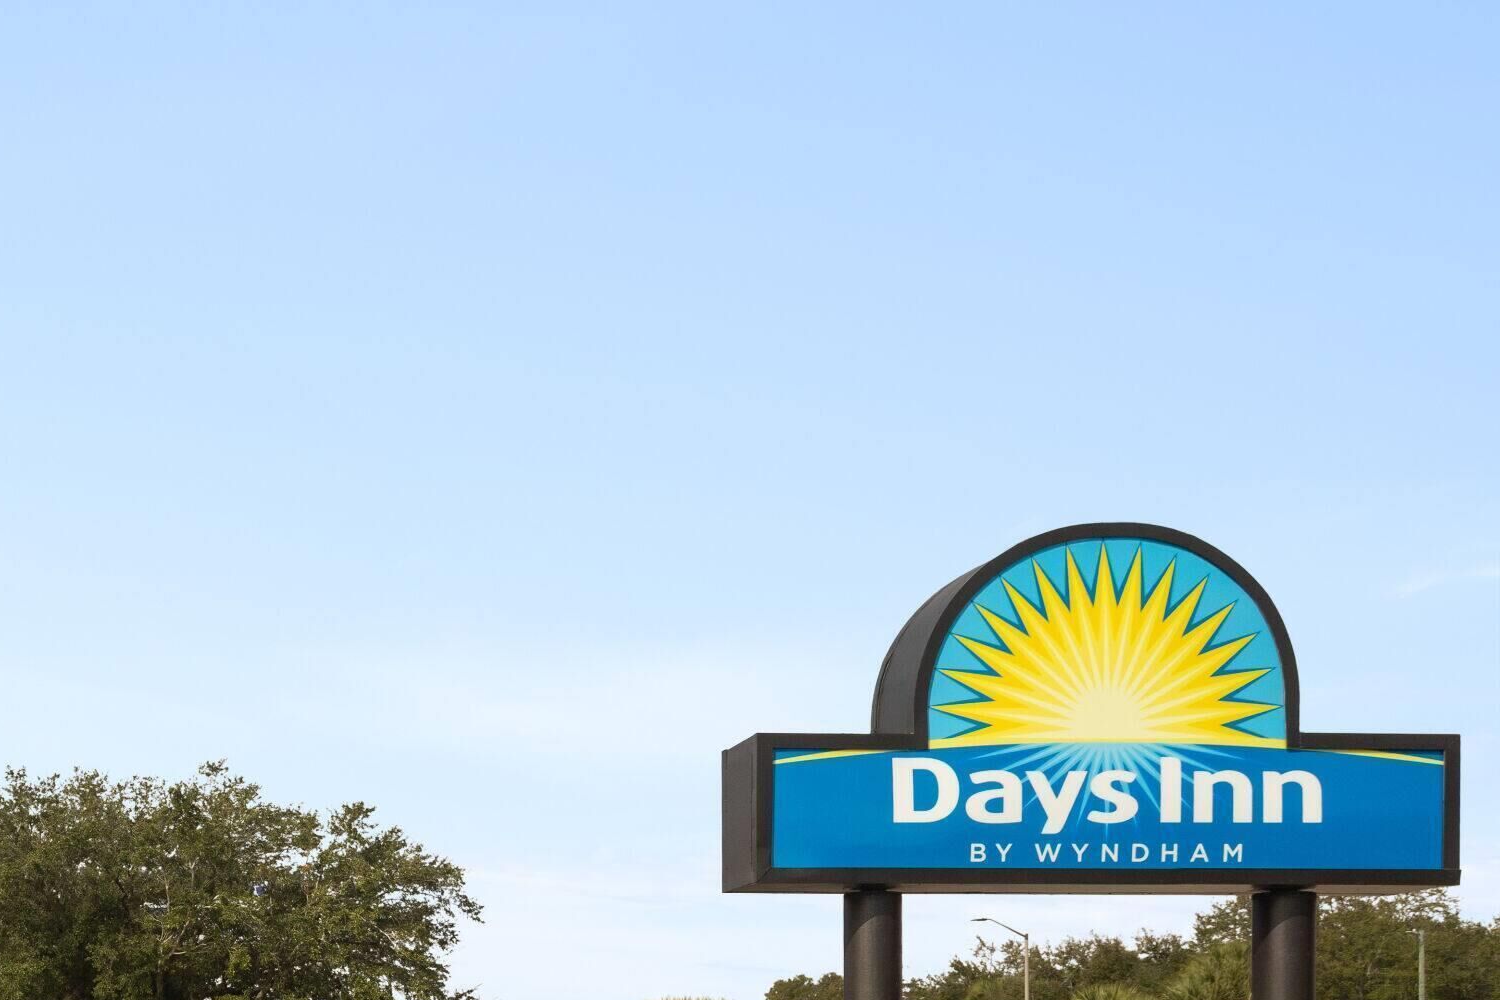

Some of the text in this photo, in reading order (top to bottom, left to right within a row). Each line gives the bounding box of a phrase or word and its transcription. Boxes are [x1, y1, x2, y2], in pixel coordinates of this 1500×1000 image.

[892, 757, 1323, 834] Days Inn
[970, 843, 1244, 863] BY WYNDHAM
